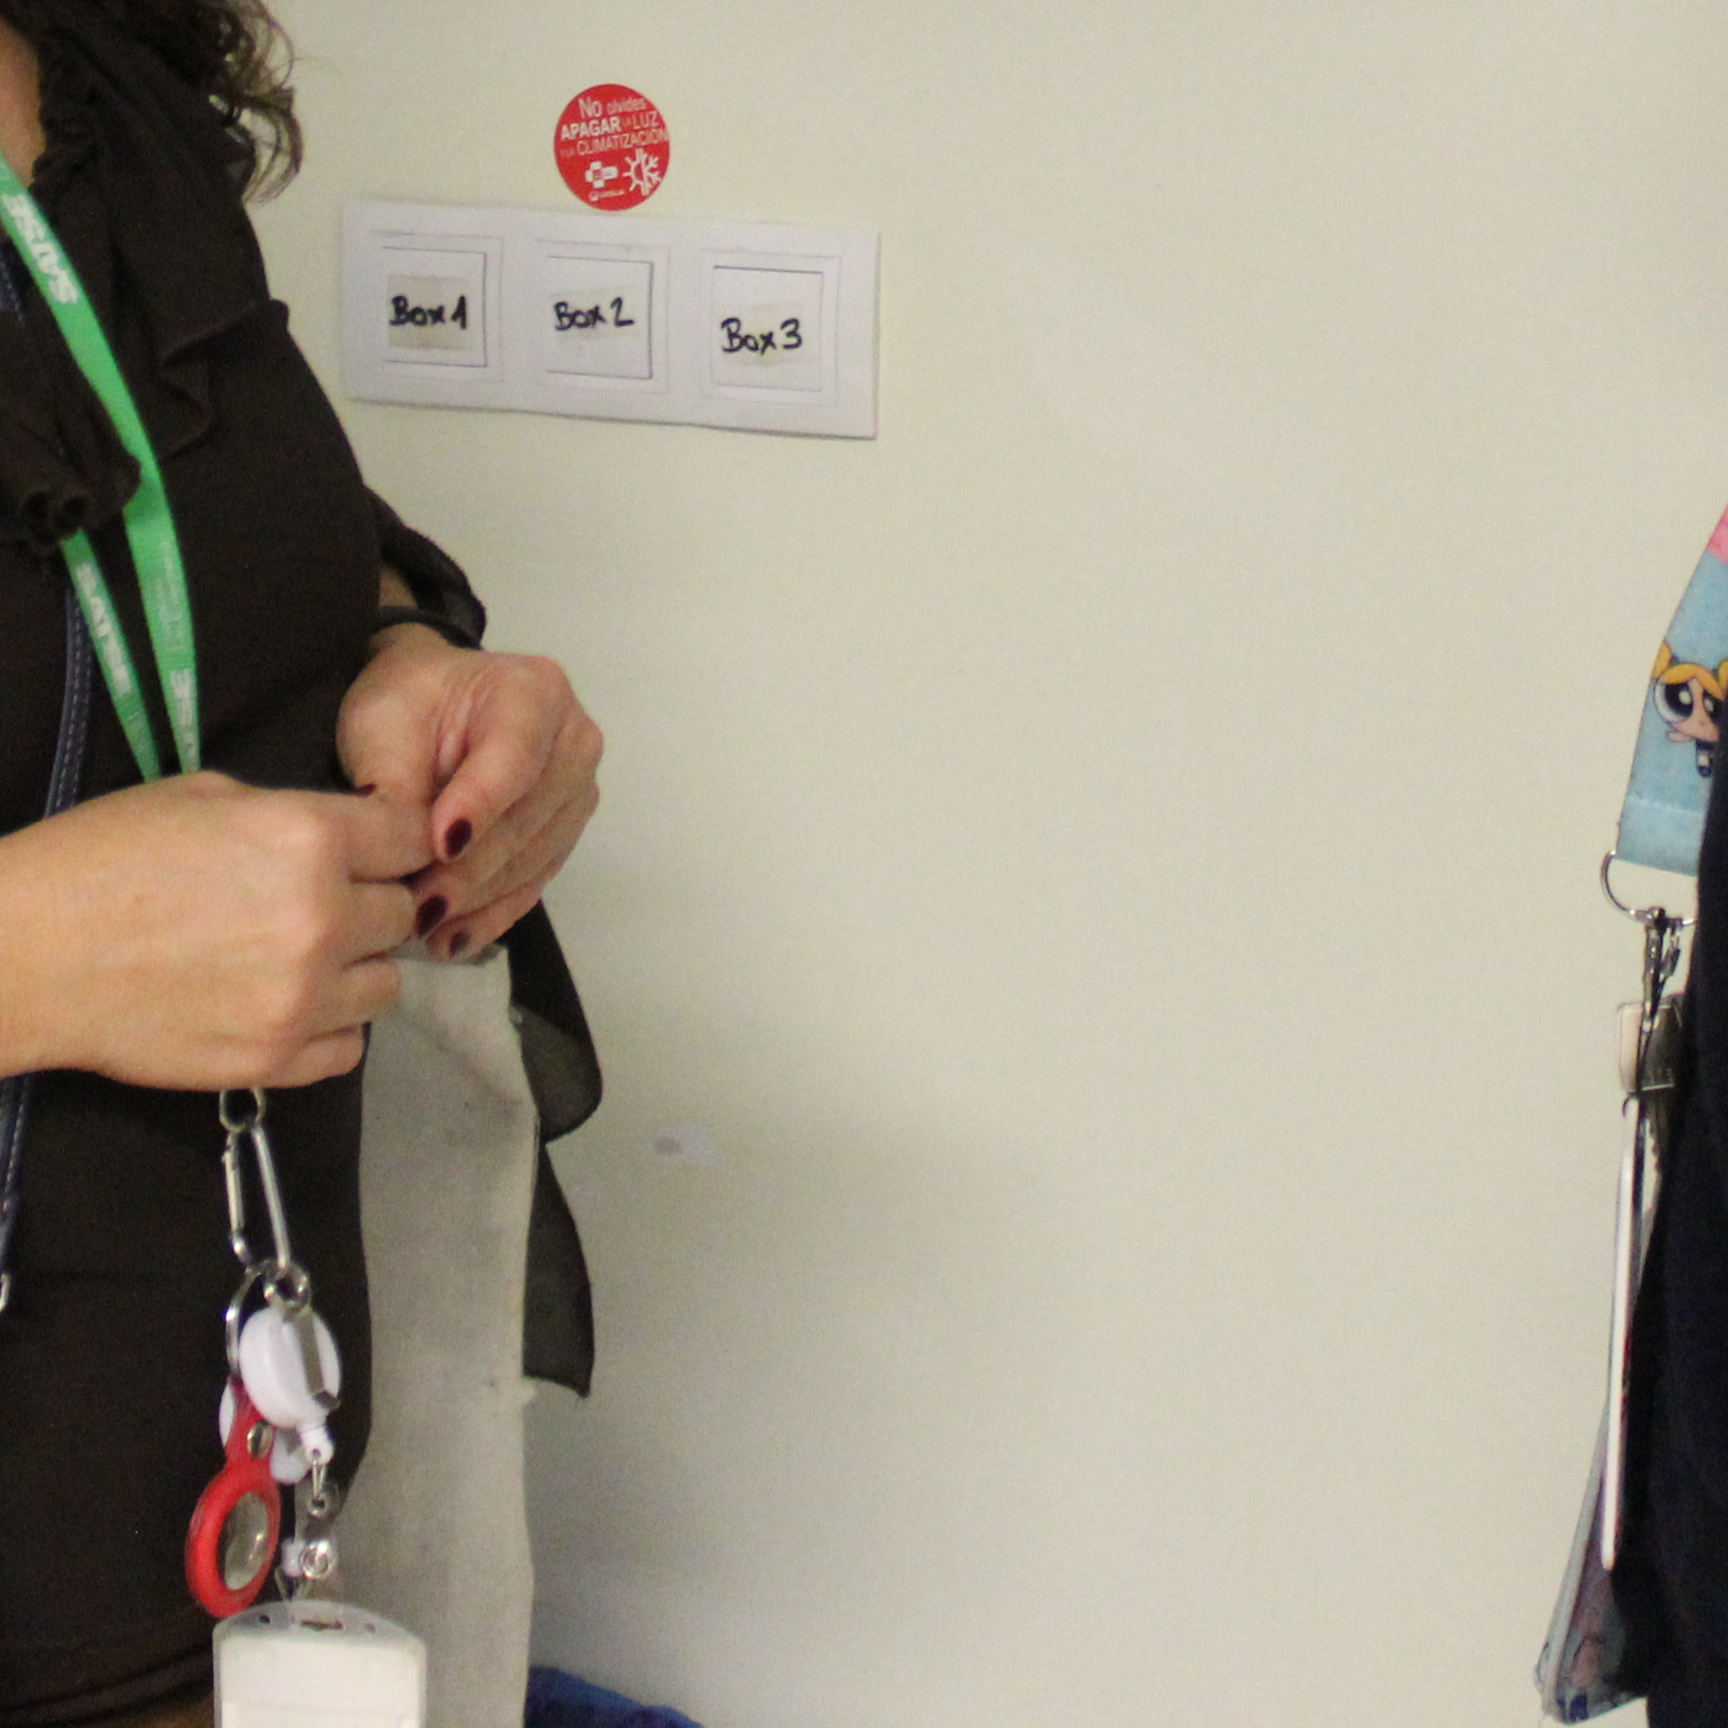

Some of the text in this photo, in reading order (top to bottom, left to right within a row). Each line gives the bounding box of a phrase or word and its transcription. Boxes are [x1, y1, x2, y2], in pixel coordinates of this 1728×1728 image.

[560, 116, 622, 140] APAGAR
[632, 110, 659, 130] LUZ
[389, 294, 468, 330] Box 1
[554, 296, 635, 331] Box 2
[720, 316, 803, 356] Box 3
